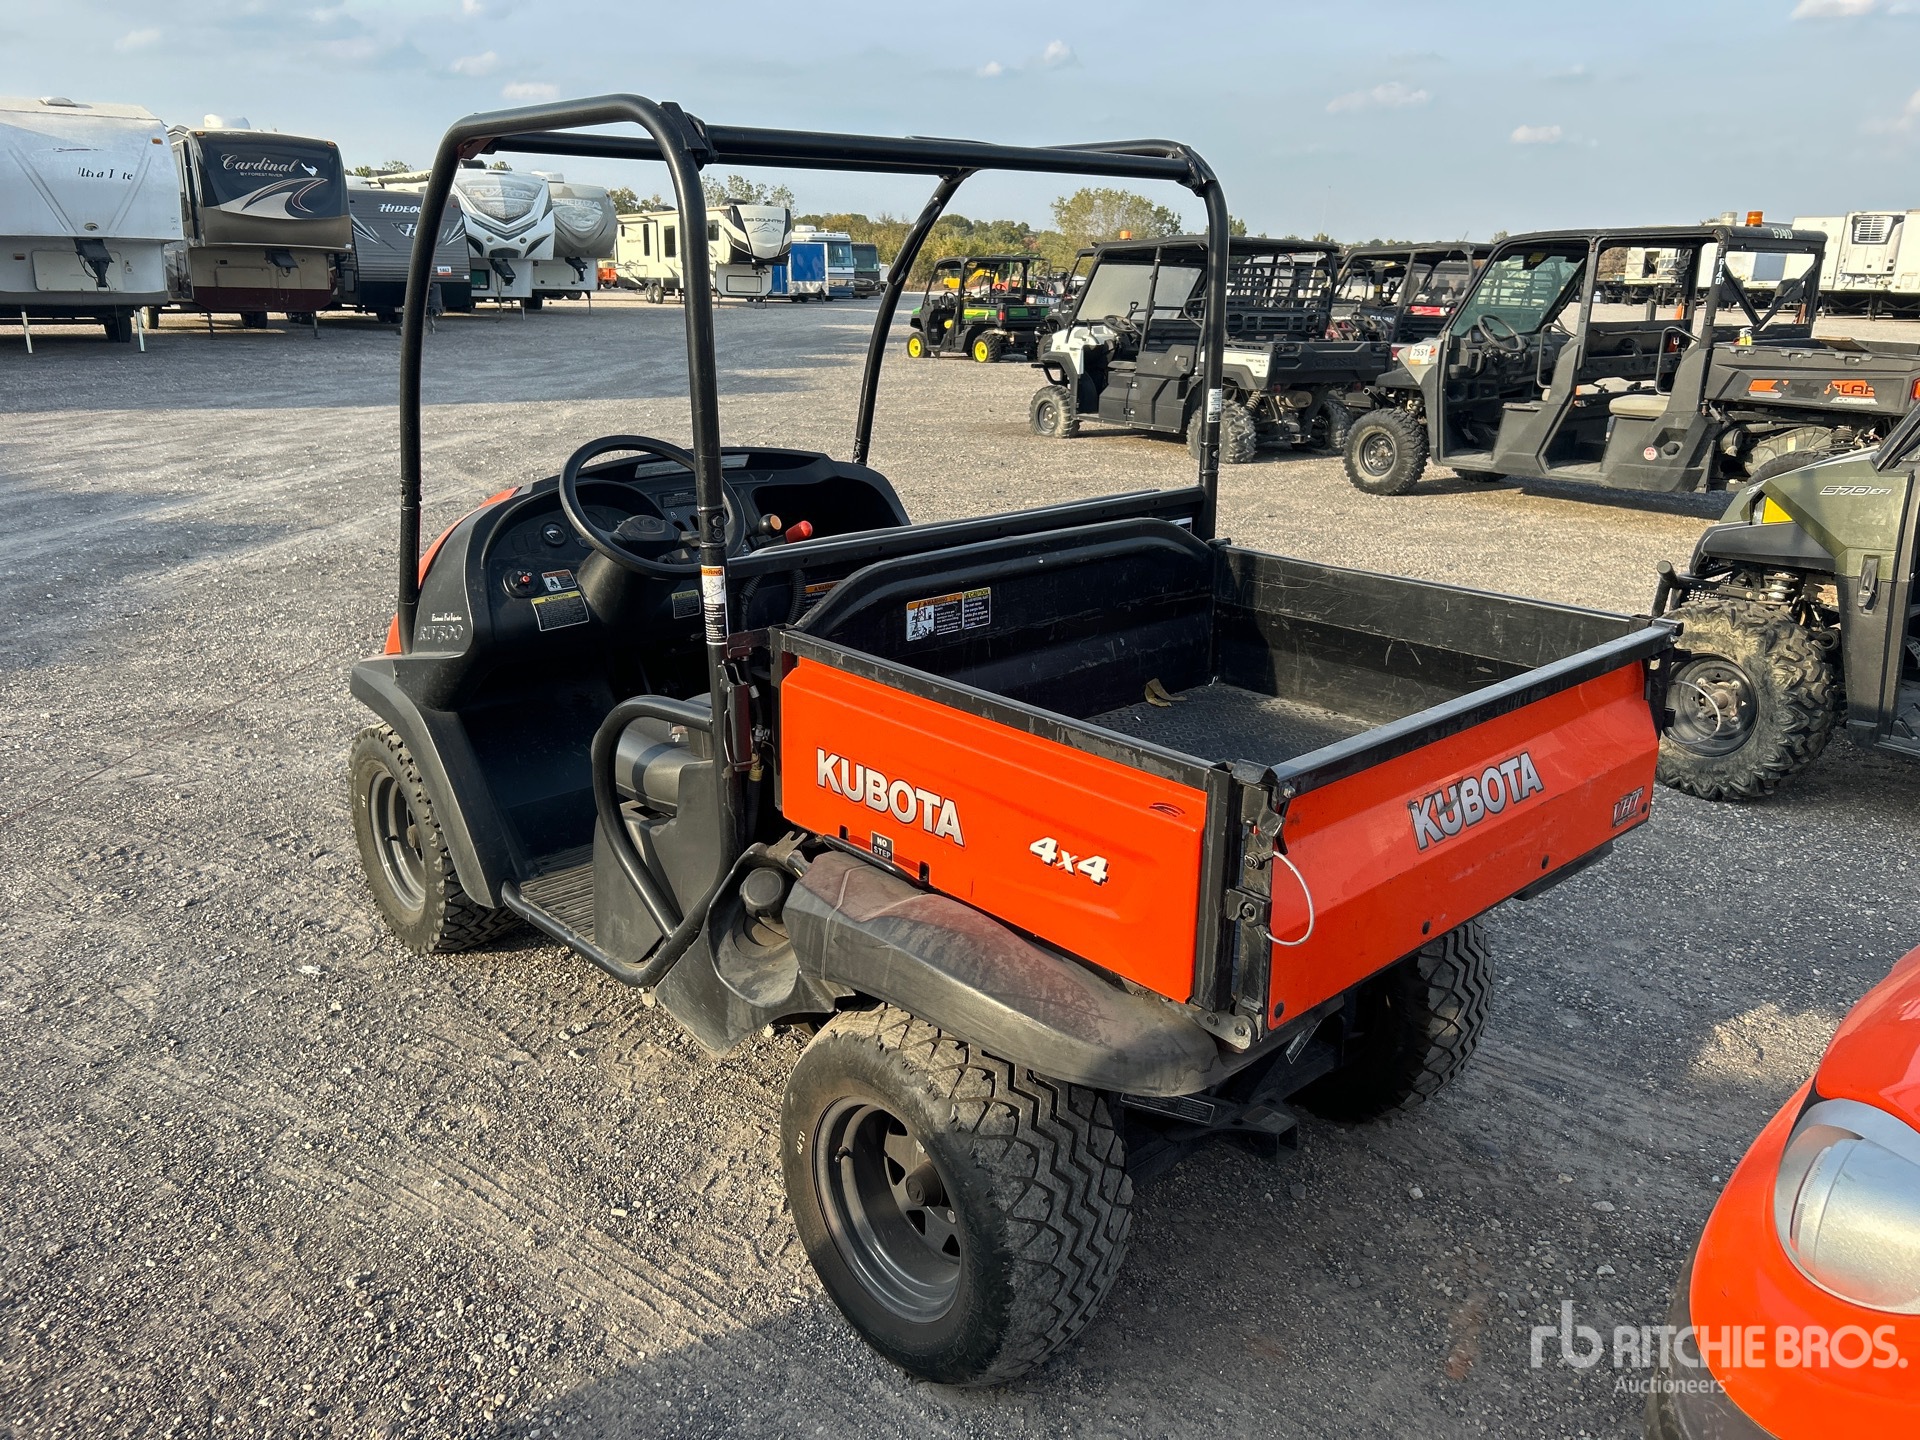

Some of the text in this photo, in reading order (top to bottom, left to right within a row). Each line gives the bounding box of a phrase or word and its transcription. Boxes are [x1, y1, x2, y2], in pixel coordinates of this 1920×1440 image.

[221, 154, 299, 172] Cardinal
[1772, 228, 1794, 240] 6140
[1715, 257, 1725, 285] 6140
[1413, 347, 1428, 356] 7551
[1820, 485, 1871, 496] 570
[816, 747, 965, 847] KUBOTA
[1408, 751, 1545, 850] KUBOTA
[876, 836, 888, 848] NO
[873, 845, 891, 859] STEP
[1029, 836, 1109, 886] 4x4
